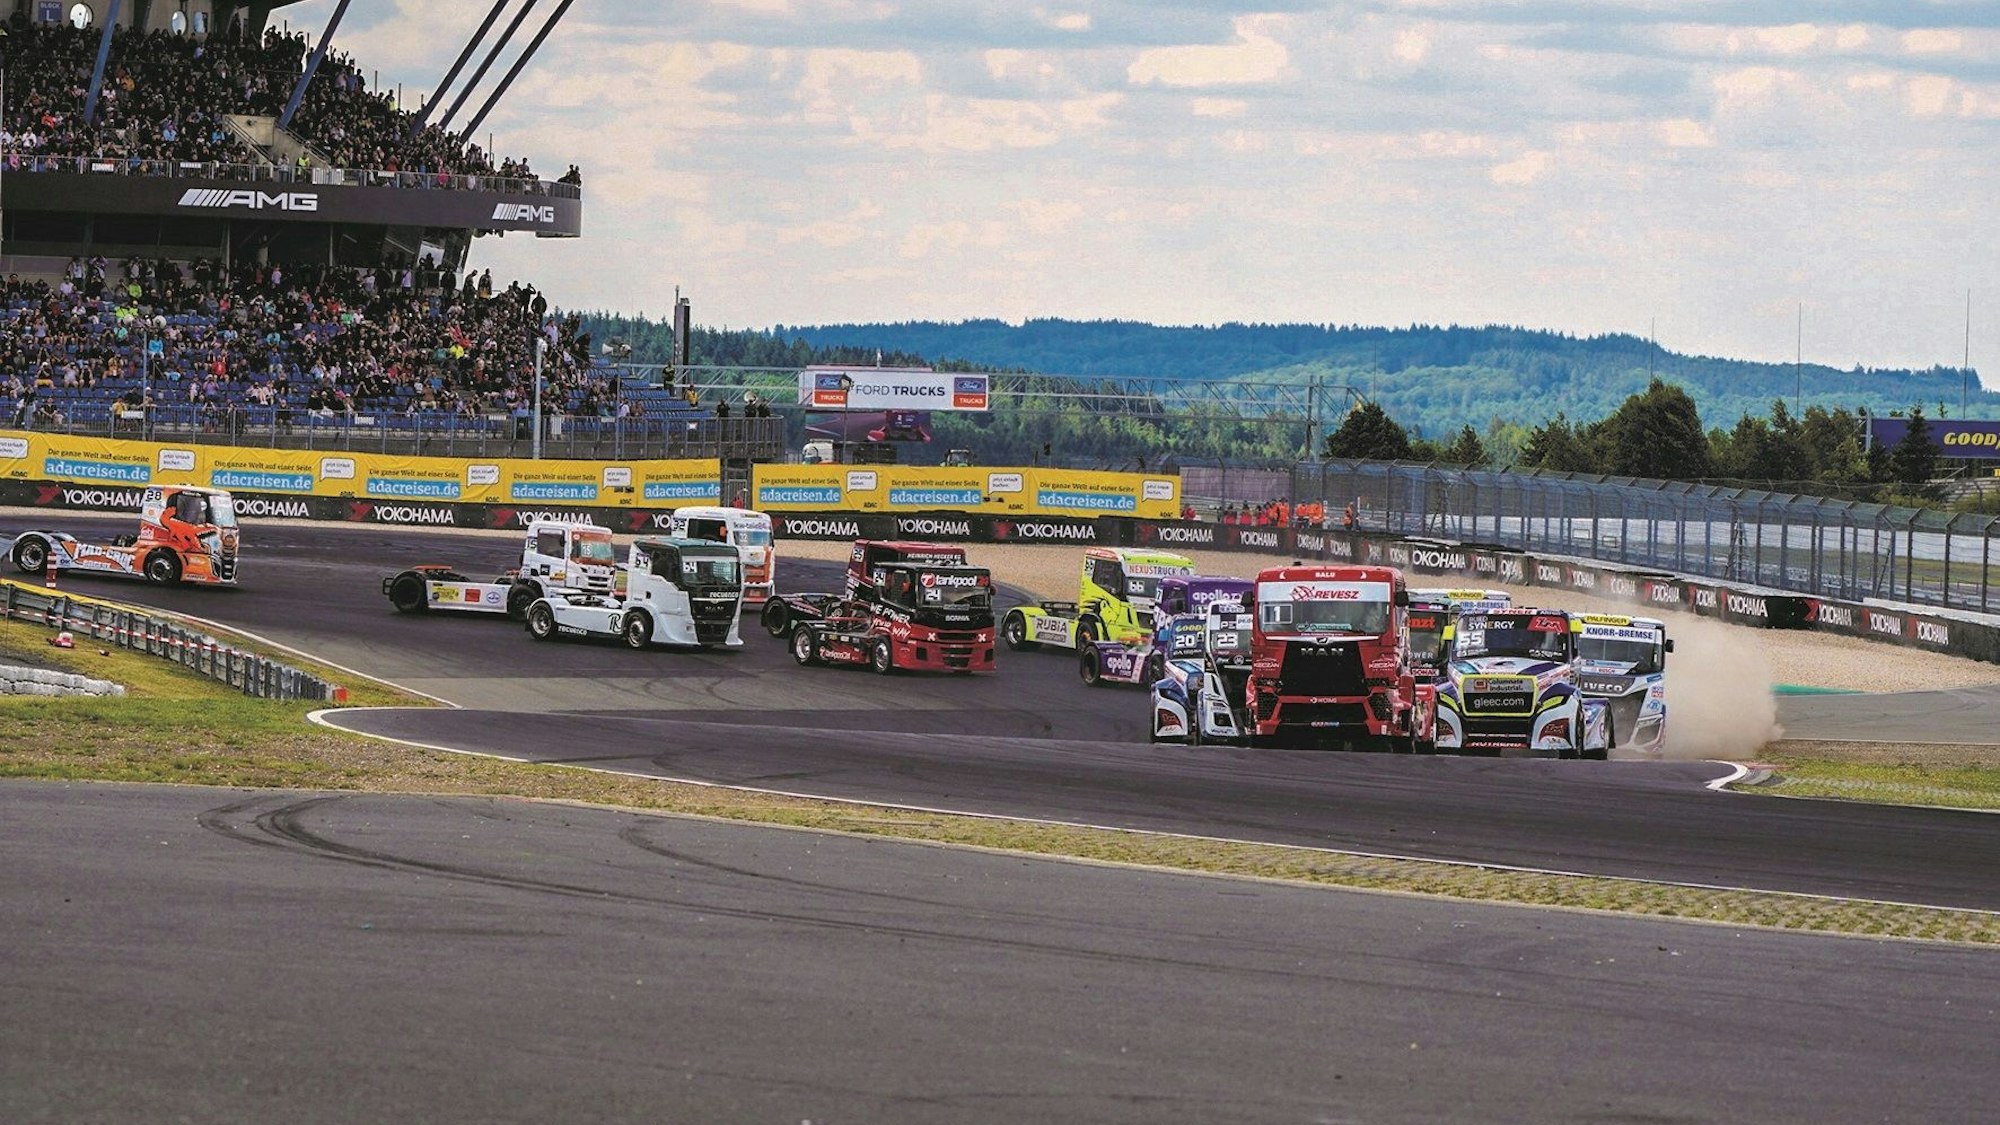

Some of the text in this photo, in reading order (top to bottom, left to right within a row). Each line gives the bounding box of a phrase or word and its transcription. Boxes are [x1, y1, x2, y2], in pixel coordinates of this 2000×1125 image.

[46, 10, 54, 21] L
[221, 189, 318, 212] AMG
[513, 204, 554, 223] AMG
[856, 385, 945, 397] FORD TRUCKS
[958, 397, 984, 405] TRUCKS
[46, 461, 149, 480] adacreisen.de
[400, 469, 415, 477] Welt
[213, 472, 312, 489] adacreisen.de
[368, 480, 459, 496] adacreisen.de
[512, 484, 596, 498] adacreisen.de
[645, 483, 720, 498] adacreisen.de
[147, 491, 162, 501] 28
[760, 489, 840, 502] adacreisen.de
[891, 490, 979, 503] adacreisen.de
[1039, 493, 1134, 509] adacreisen.de
[374, 505, 454, 524] YOKOHAMA
[516, 511, 593, 525] YOKOHAMA
[785, 519, 860, 536] YOKOHAMA
[898, 518, 970, 536] YOKOHAMA
[1016, 523, 1096, 539] YOKOHAMA
[1158, 527, 1213, 543] YOKOHAMA
[683, 561, 697, 574] 64
[1129, 580, 1144, 592] 66
[925, 590, 940, 600] 24
[1192, 589, 1230, 604] apollo
[1314, 591, 1360, 599] REVESZ
[870, 602, 912, 629] WE POWER
[1586, 616, 1627, 624] PALFINGER
[1468, 621, 1515, 630] SYNERGY
[1460, 633, 1482, 645] 55
[1586, 627, 1654, 640] KNORR-BREMSE
[1176, 635, 1195, 648] 20
[1218, 633, 1238, 648] 23
[1301, 648, 1344, 657] MAN
[1107, 653, 1132, 673] apollo
[1584, 681, 1623, 692] IVECO
[1474, 697, 1525, 709] gleec.com
